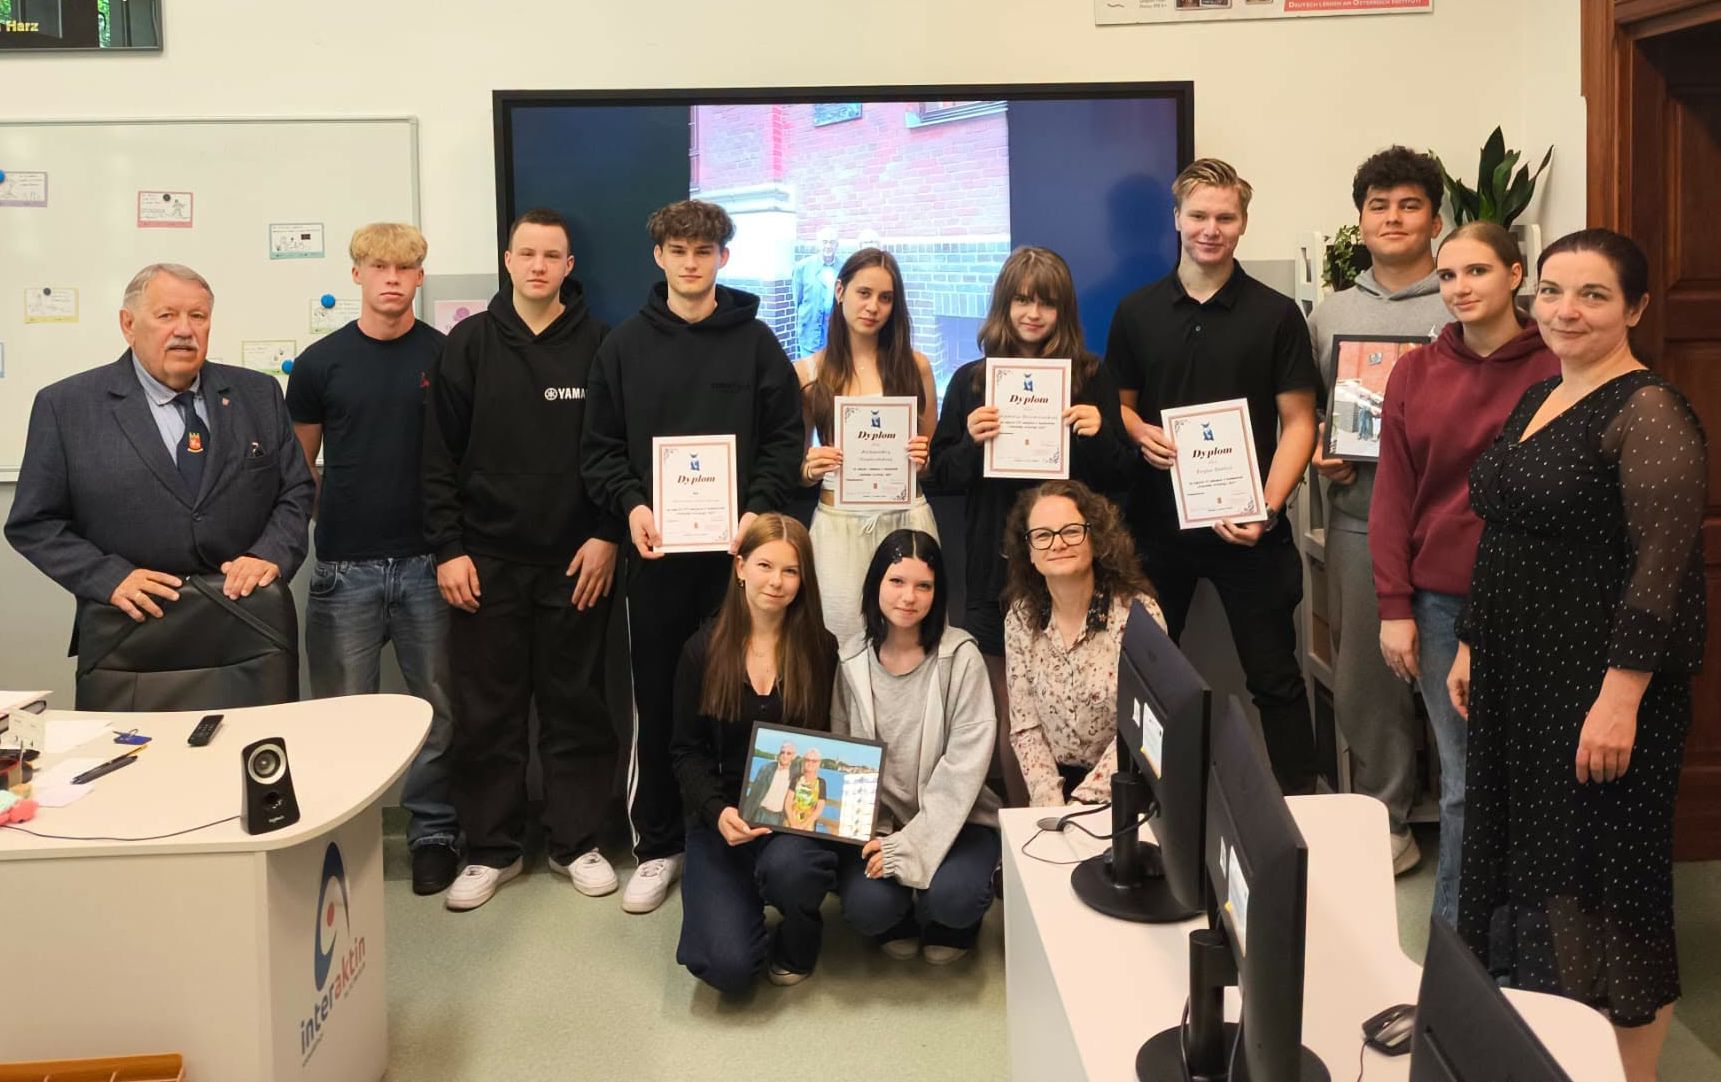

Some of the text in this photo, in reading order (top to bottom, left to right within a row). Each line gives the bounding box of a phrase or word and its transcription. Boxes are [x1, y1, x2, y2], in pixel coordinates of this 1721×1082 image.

[6, 20, 39, 32] Harz
[558, 387, 588, 400] YAMA
[1009, 394, 1049, 405] Dyplom
[857, 431, 896, 441] Dyplom
[1192, 447, 1233, 459] Dyplom
[677, 475, 716, 486] Dyplom
[301, 937, 366, 1055] interaktin
